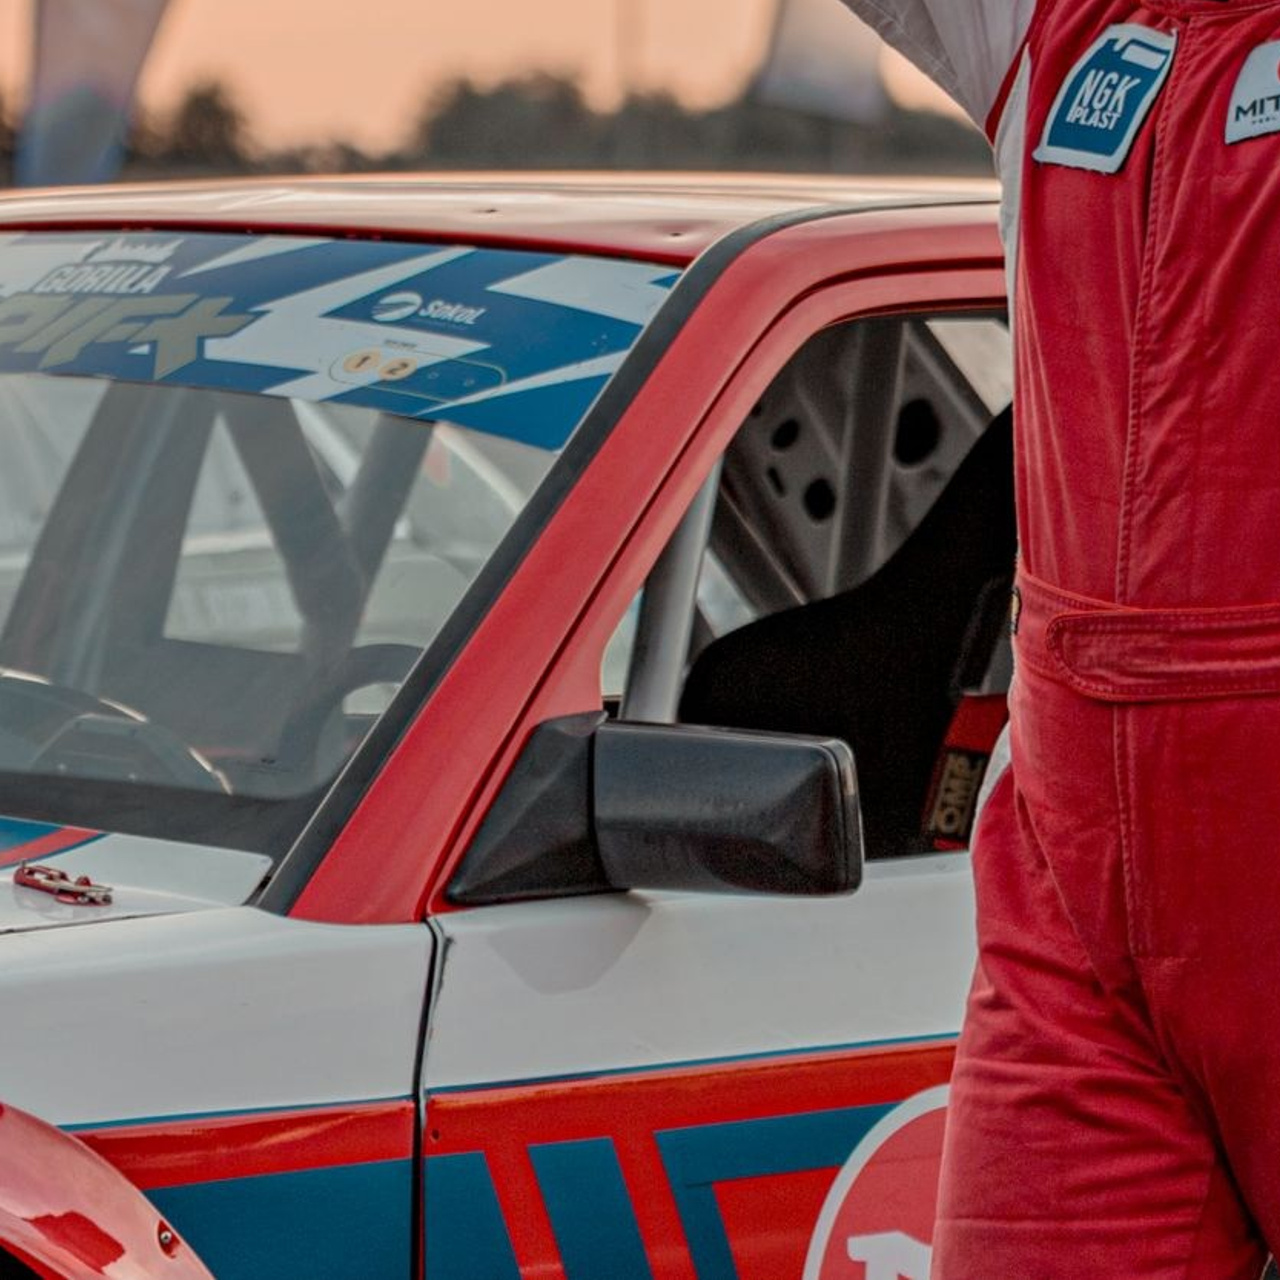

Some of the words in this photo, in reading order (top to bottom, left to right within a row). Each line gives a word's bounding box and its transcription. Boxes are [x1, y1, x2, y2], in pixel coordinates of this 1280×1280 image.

[1065, 68, 1142, 122] NGK
[1070, 105, 1121, 131] PLAST
[33, 264, 172, 294] GORILLA
